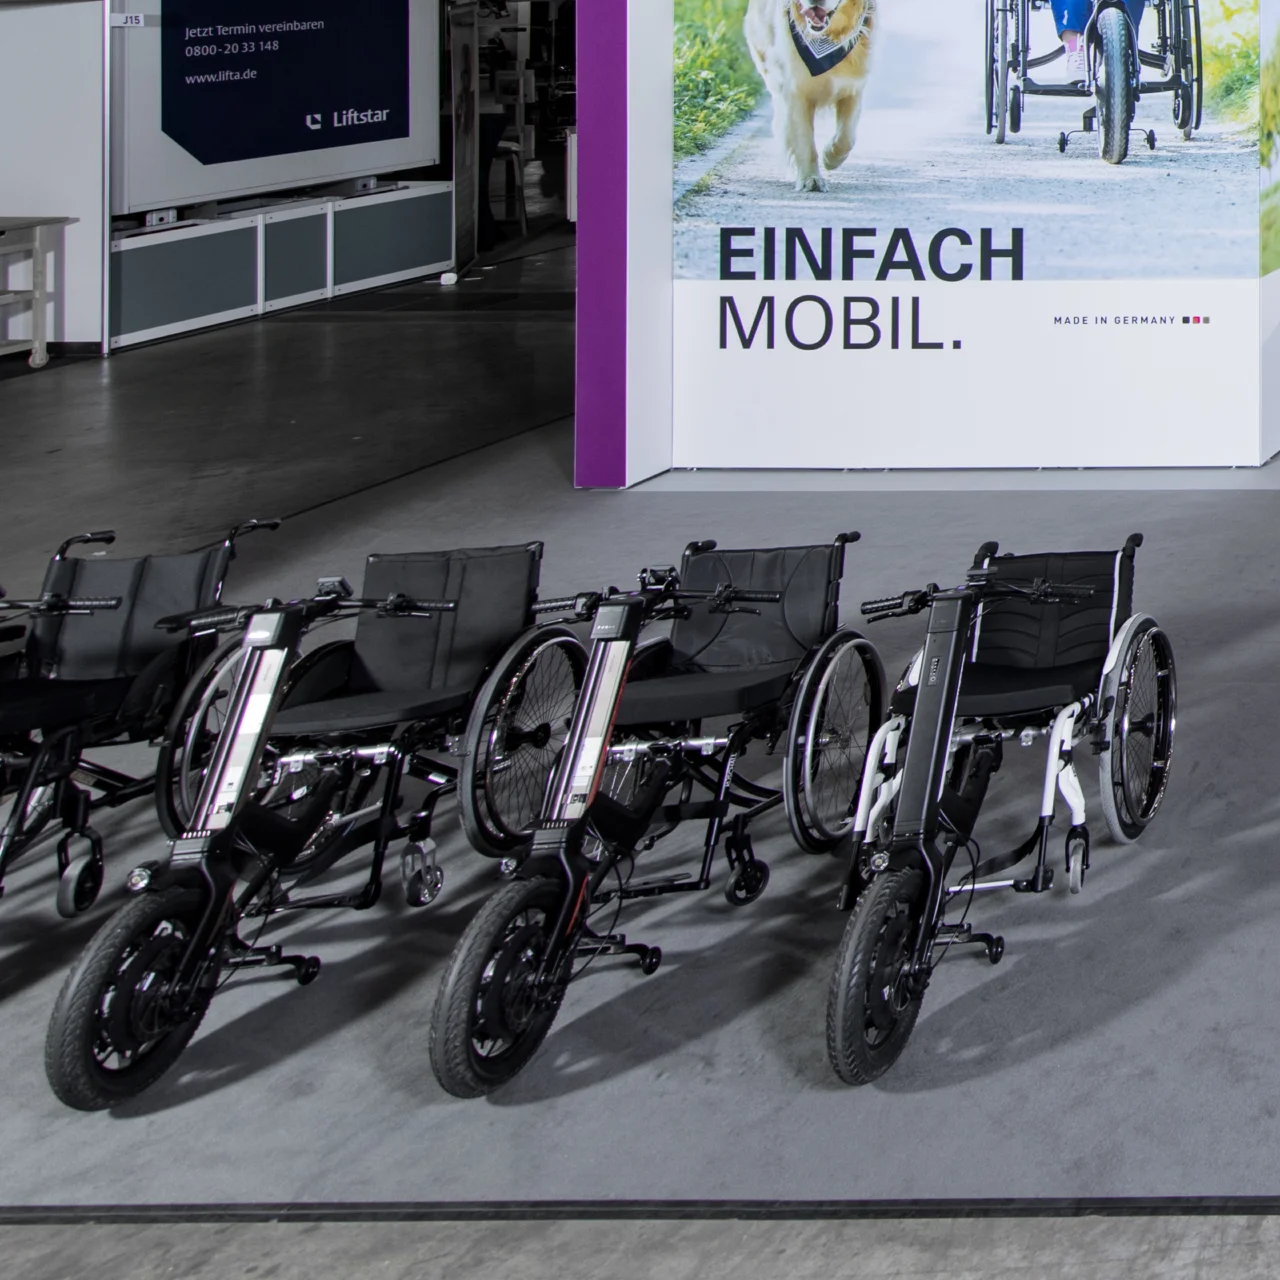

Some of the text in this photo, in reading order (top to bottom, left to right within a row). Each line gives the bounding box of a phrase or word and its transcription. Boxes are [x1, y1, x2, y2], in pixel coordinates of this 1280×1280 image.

[122, 15, 141, 25] J15
[184, 19, 325, 41] Jetzt Termin vereinbaren
[241, 42, 256, 53] 33
[258, 40, 280, 52] 148
[184, 68, 258, 85] www.lifta.de
[332, 108, 391, 128] Liftstar
[718, 227, 1025, 282] EINFACH
[718, 294, 963, 351] MOBIL.
[1053, 316, 1177, 326] MADE IN GERMANY
